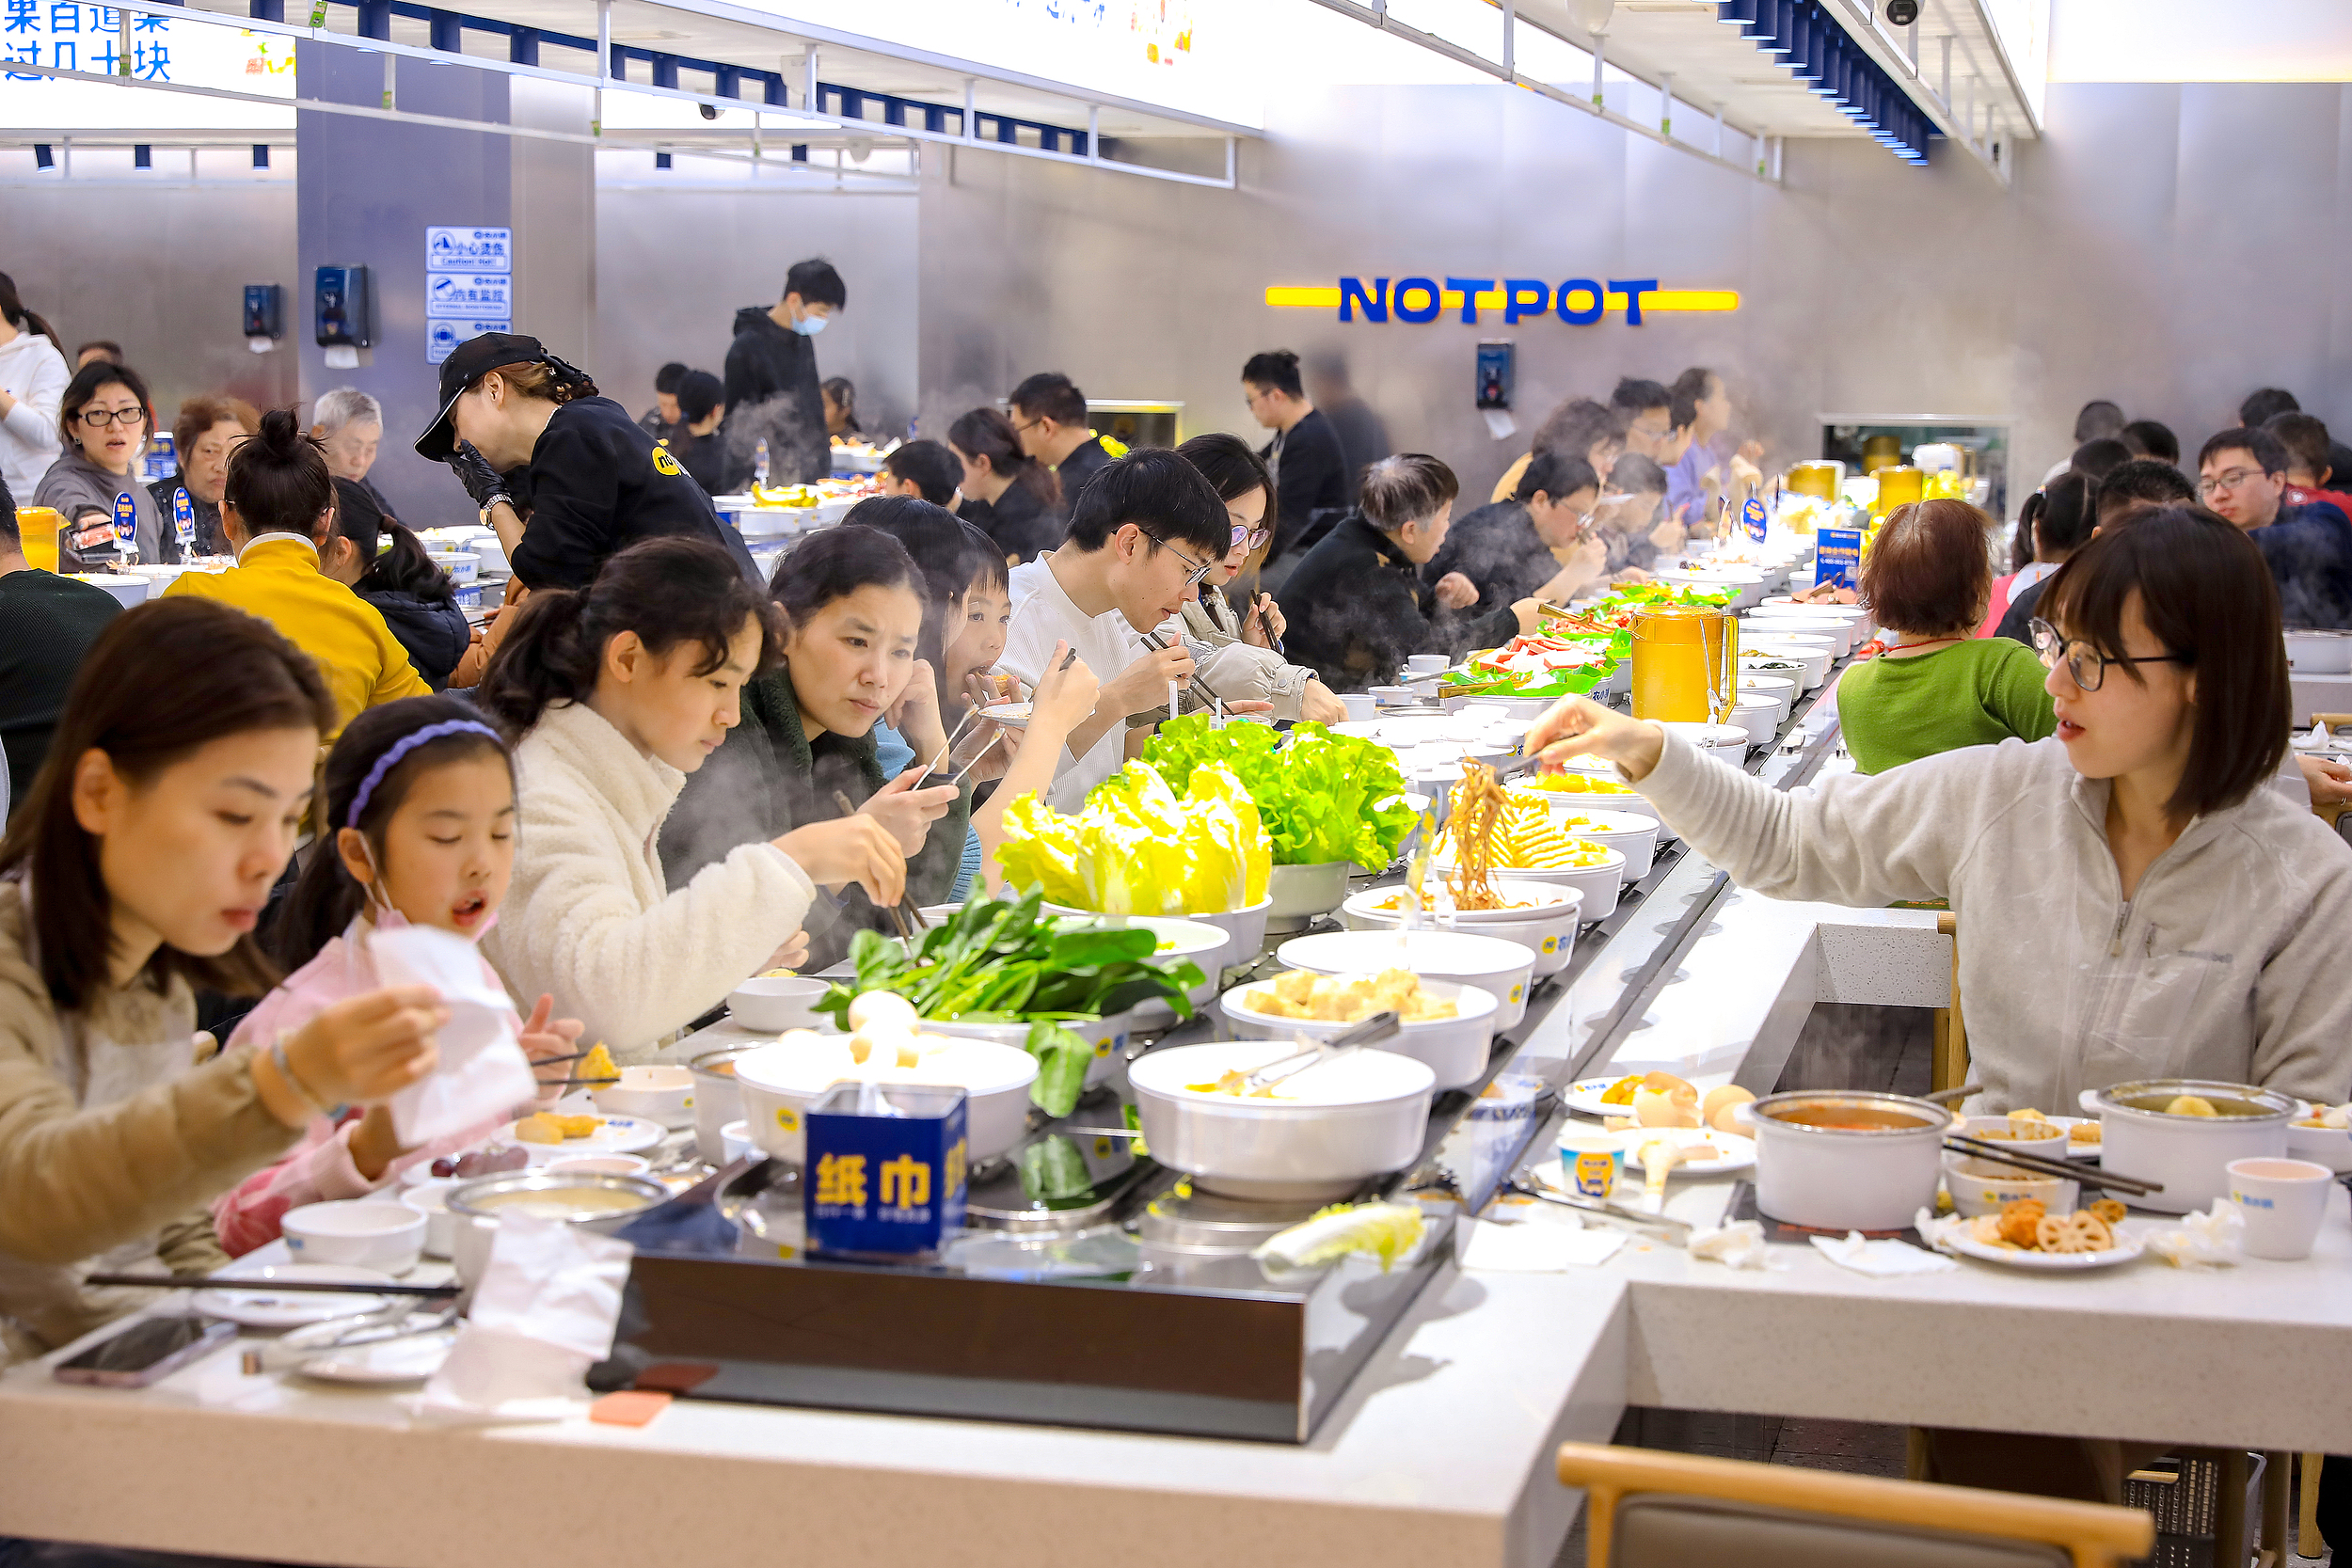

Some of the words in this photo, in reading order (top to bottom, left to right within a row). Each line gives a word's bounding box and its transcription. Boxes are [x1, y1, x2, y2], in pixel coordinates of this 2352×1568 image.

[5, 40, 171, 81] 过几十块
[1340, 277, 1659, 325] NOTPOT
[815, 1152, 930, 1209] 纸巾
